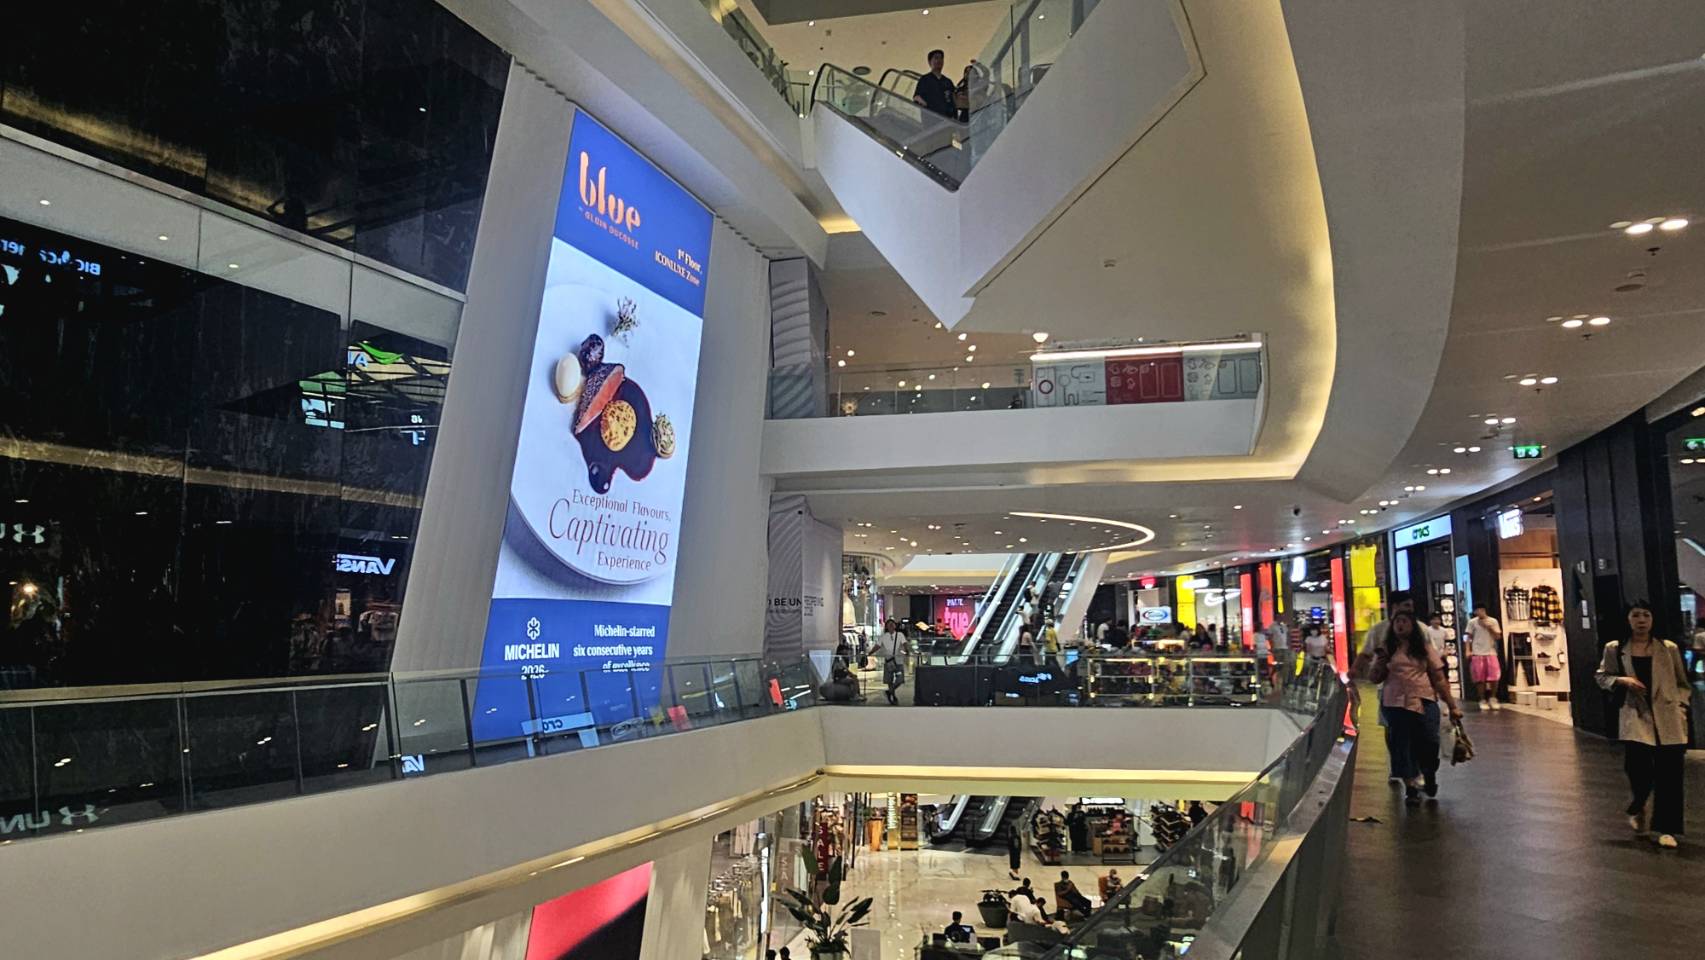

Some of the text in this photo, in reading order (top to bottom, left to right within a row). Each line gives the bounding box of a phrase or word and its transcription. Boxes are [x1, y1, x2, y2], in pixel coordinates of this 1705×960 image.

[579, 151, 641, 233] blue
[572, 488, 671, 521] Exceptional Flavours,
[549, 498, 670, 565] Captivating
[597, 551, 652, 571] Experience
[594, 624, 655, 638] Michelin-starred
[504, 643, 560, 661] MICHELIN
[573, 643, 653, 658] six consecutive years
[816, 826, 826, 871] SALE
